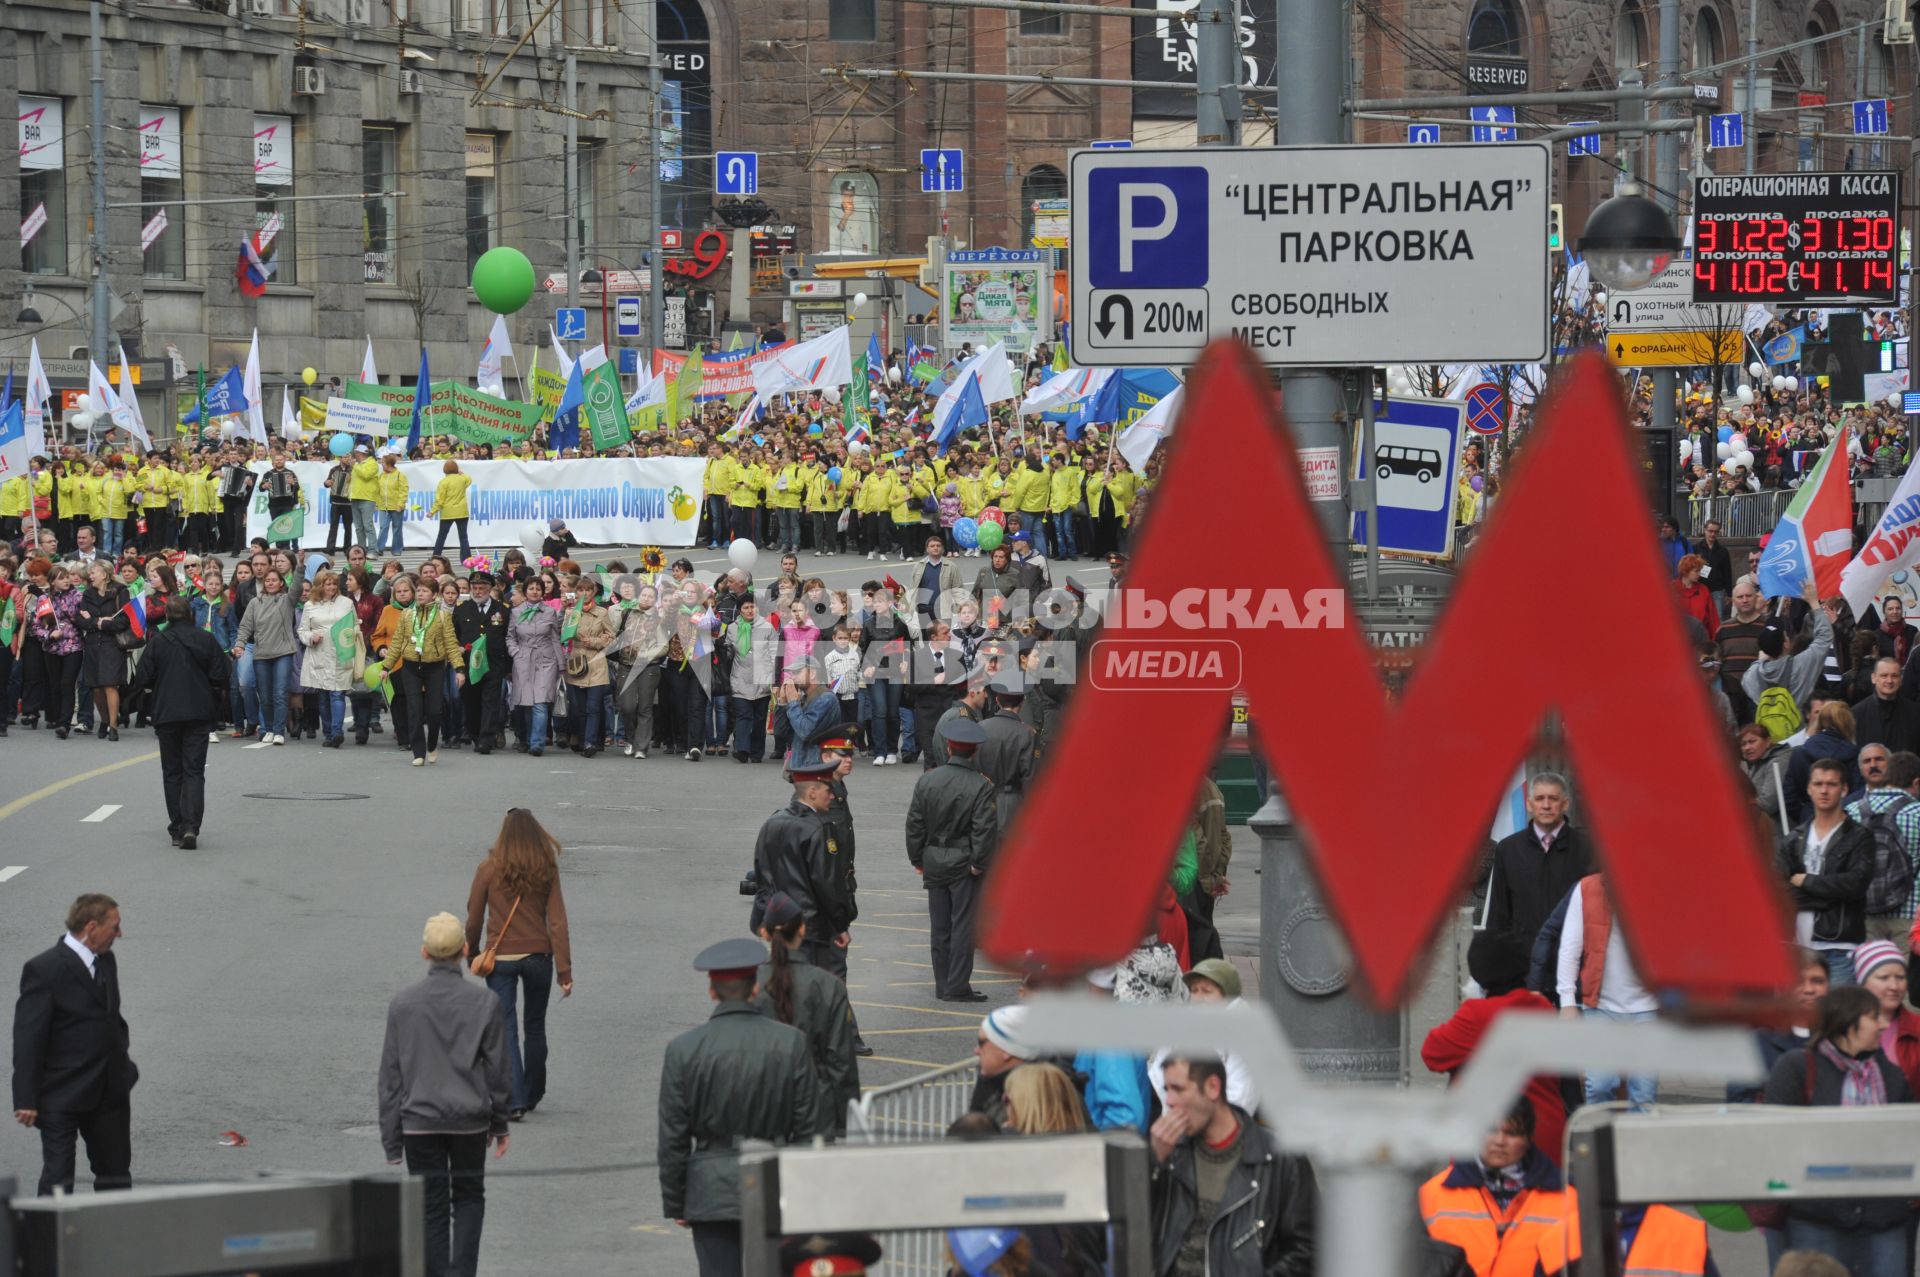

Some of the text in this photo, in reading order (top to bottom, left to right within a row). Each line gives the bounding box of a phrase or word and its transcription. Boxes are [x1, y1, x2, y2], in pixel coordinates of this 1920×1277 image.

[1469, 66, 1527, 86] RESERVED
[25, 125, 41, 140] BAR
[145, 135, 160, 149] BAR
[259, 143, 273, 156] БАР
[1701, 176, 1890, 197] ОПЕРАЦИОННАЯ КАССА
[1119, 182, 1179, 272] P
[1698, 219, 1789, 252] 31.22
[1803, 217, 1893, 251] 31.30
[1279, 229, 1475, 263] ПАРКОВКА
[958, 252, 1030, 261] ПЕРЕХОД
[1695, 260, 1787, 293] 41.02
[1231, 291, 1389, 318] СВОБОДНЫХ
[1635, 300, 1686, 310] ОХОТНЫЙ
[1635, 313, 1664, 323] улица
[1232, 325, 1297, 349] МЕСТ
[1631, 344, 1687, 354] ФОРАБАНК
[342, 402, 377, 414] Восточный
[469, 484, 618, 526] Административного
[622, 480, 665, 523] Округа
